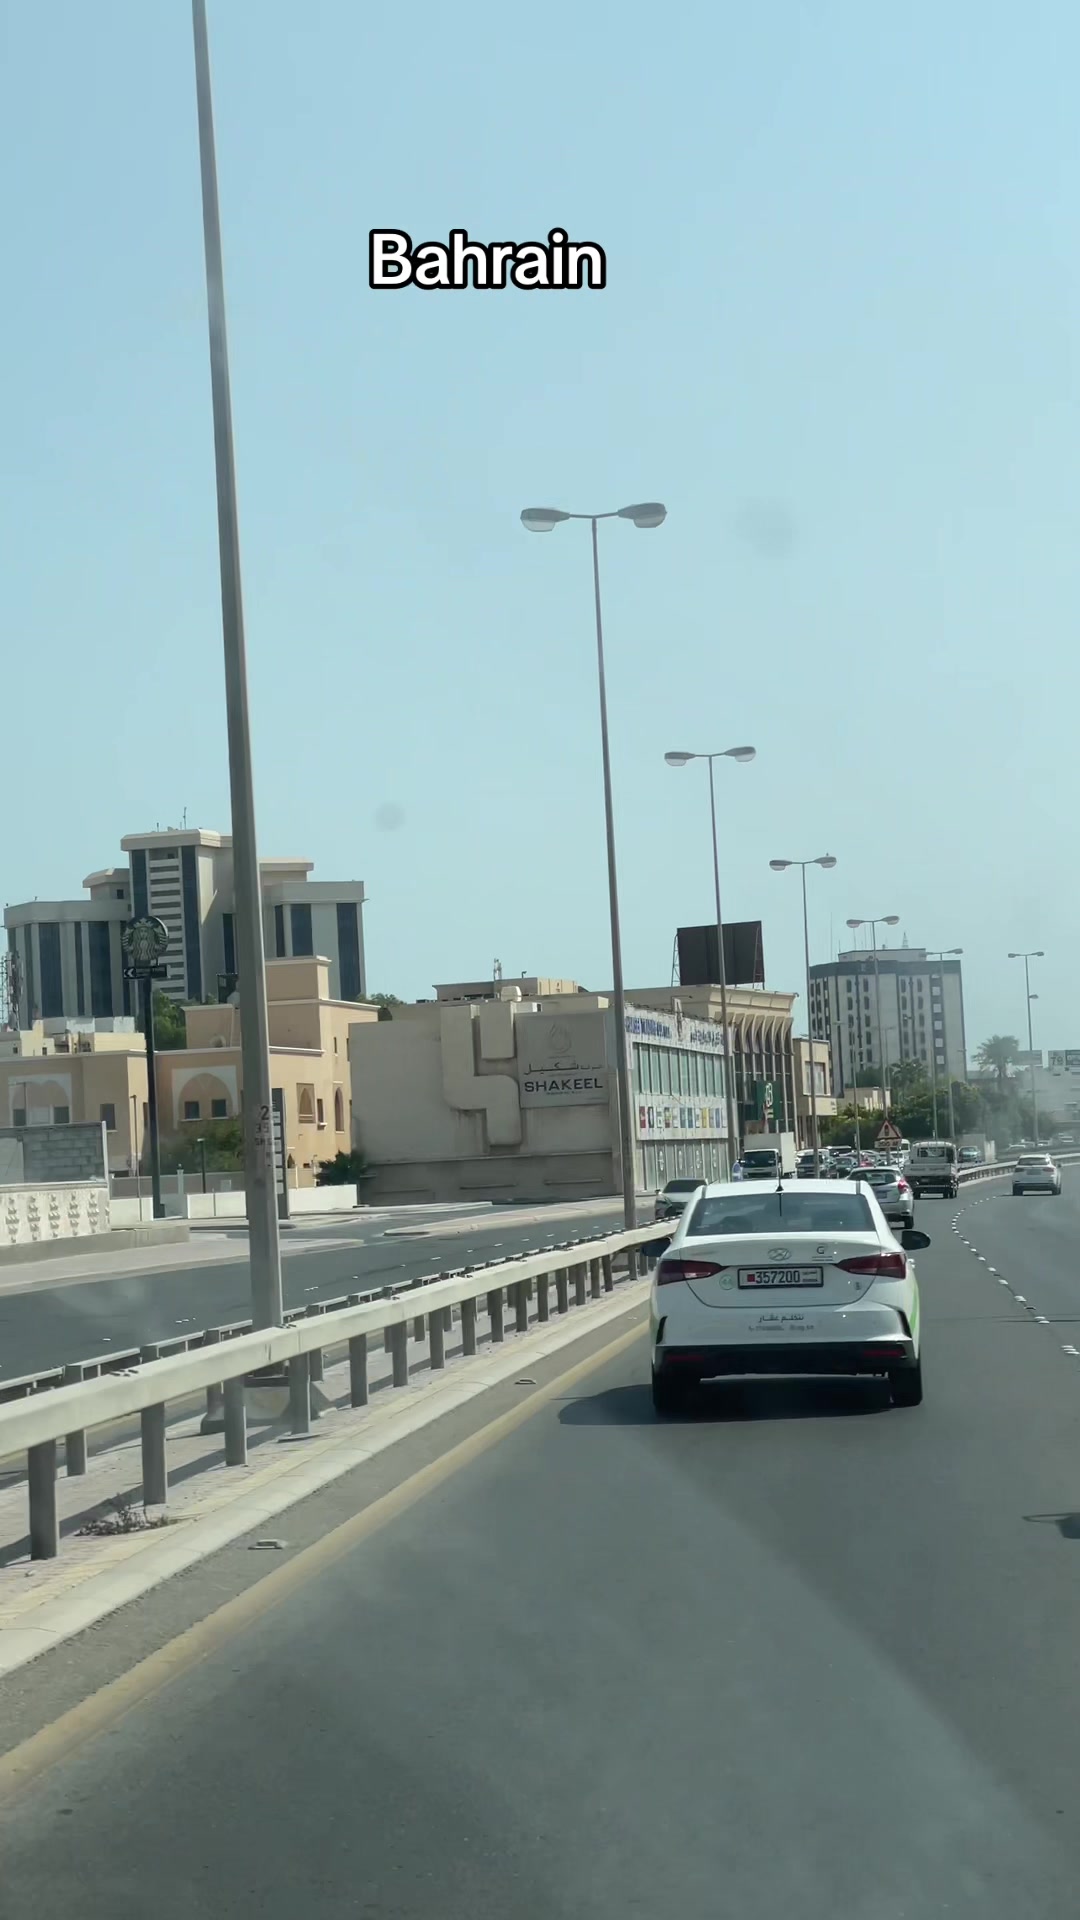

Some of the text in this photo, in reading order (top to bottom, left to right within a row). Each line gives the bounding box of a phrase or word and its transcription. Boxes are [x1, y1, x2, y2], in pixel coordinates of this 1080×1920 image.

[524, 1078, 603, 1092] SHAKEEL
[260, 1105, 269, 1120] 2
[756, 1271, 800, 1284] 357200
